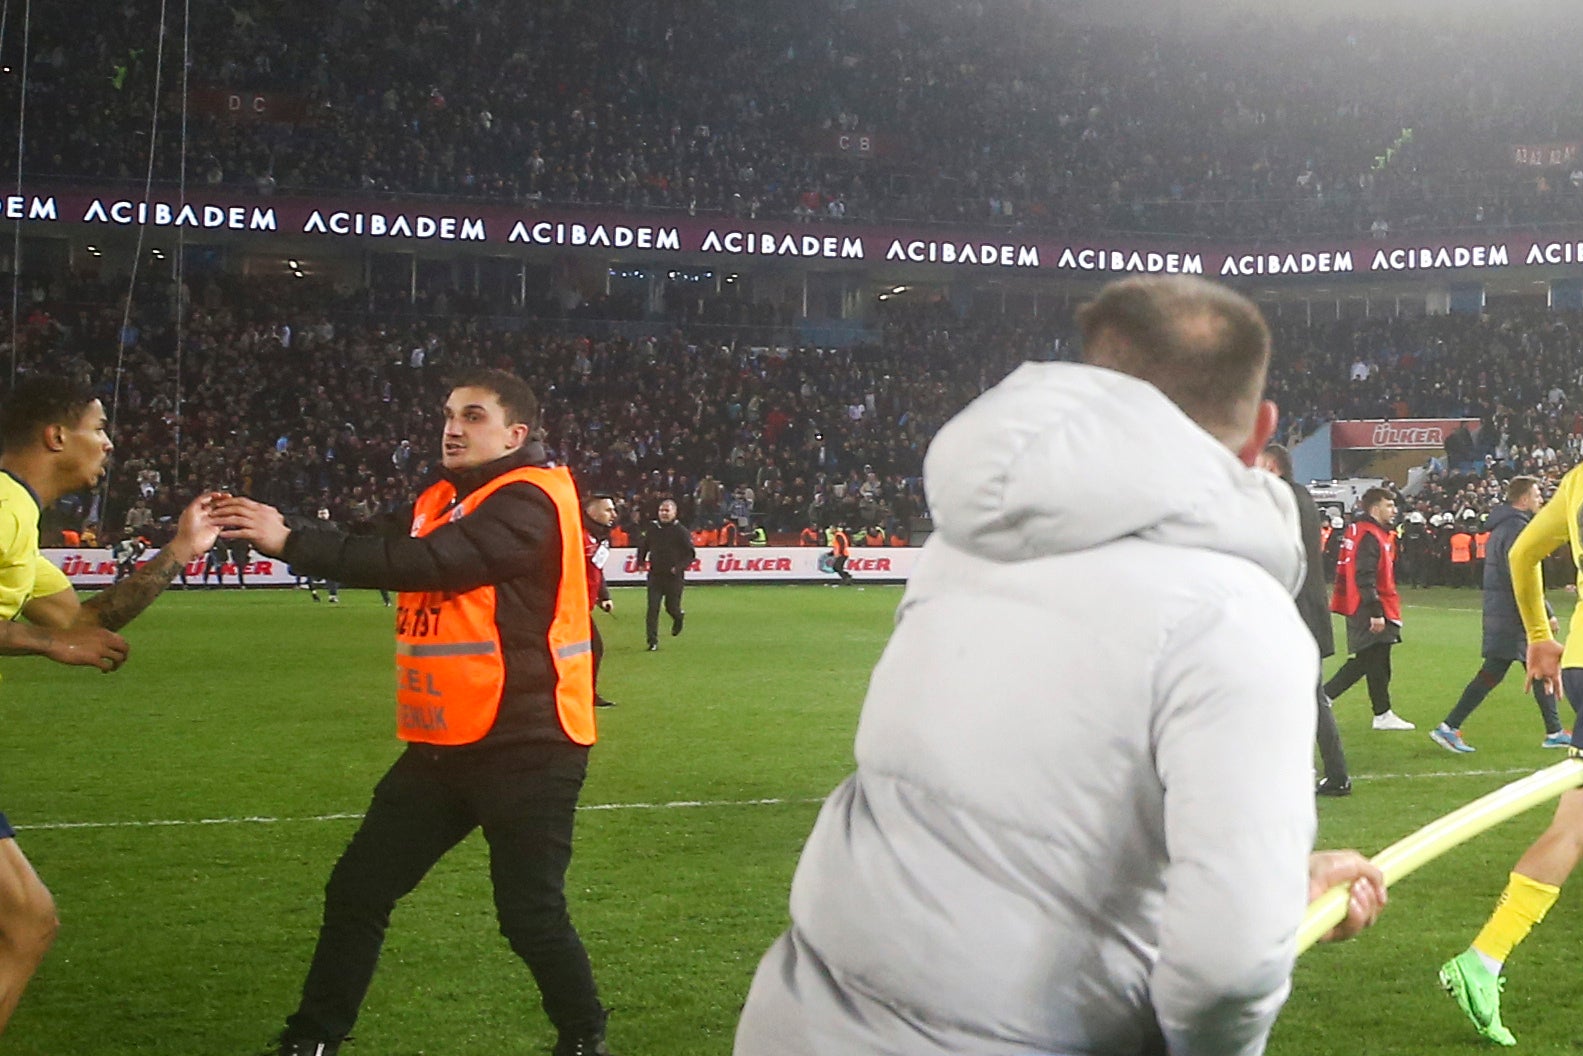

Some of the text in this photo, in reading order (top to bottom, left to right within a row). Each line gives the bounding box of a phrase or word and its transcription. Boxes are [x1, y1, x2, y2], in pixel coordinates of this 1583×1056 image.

[85, 201, 275, 229] ACIBADEM
[305, 212, 484, 239] ACIBADEM
[510, 222, 679, 249] ACIBADEM
[702, 232, 863, 257] ACIBADEM
[887, 241, 1038, 265] ACIBADEM
[1059, 249, 1202, 274] ACIBADEM
[1221, 252, 1352, 274] ACIBADEM
[1372, 246, 1508, 269] ACIBADEM
[1373, 423, 1444, 446] ÜLKER
[716, 553, 792, 573] ÜLKER
